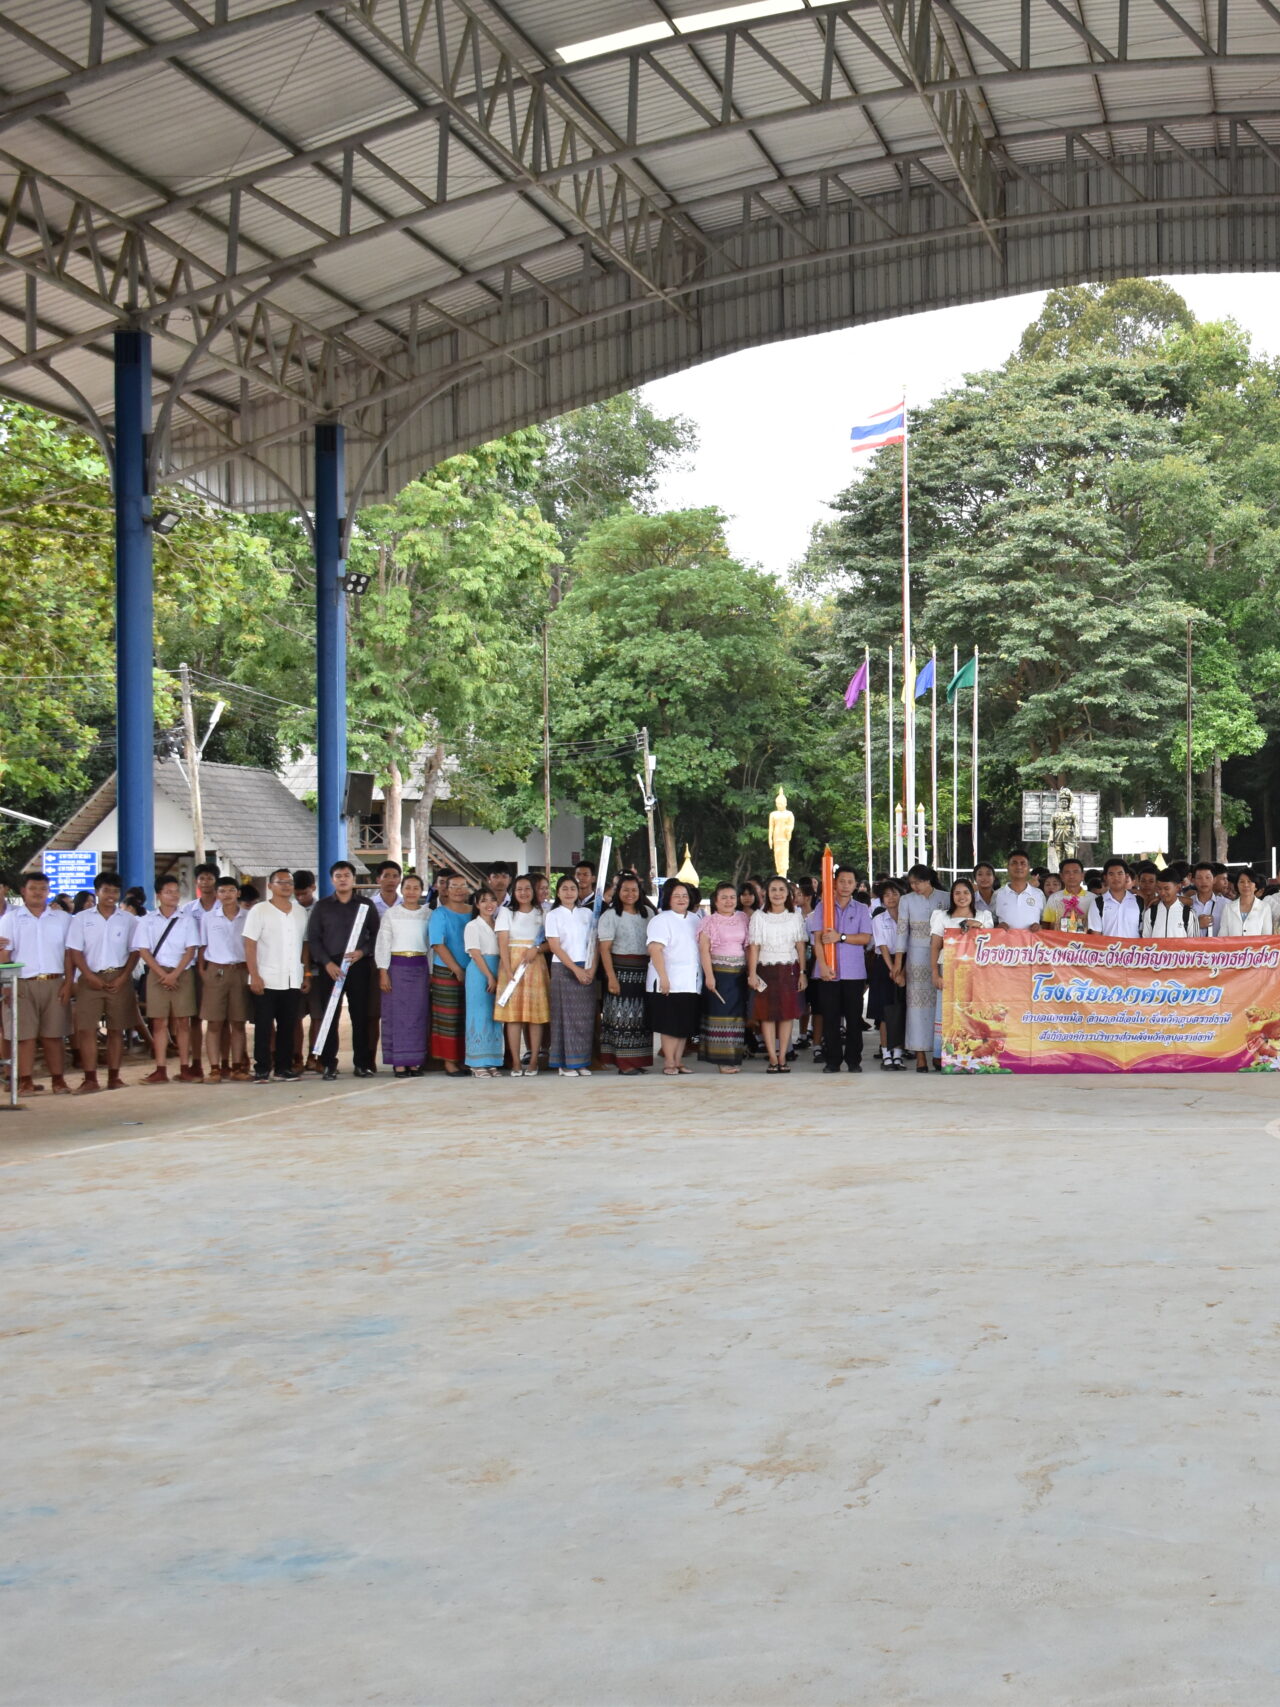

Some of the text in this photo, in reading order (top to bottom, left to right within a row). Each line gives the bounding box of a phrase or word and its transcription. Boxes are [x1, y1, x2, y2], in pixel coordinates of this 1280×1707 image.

[975, 935, 1280, 977] โครงการประเพณีและวันสำคัญทางพระพุทธศาสนา
[1032, 973, 1223, 1005] โรงเรียนนาคำวิทยา
